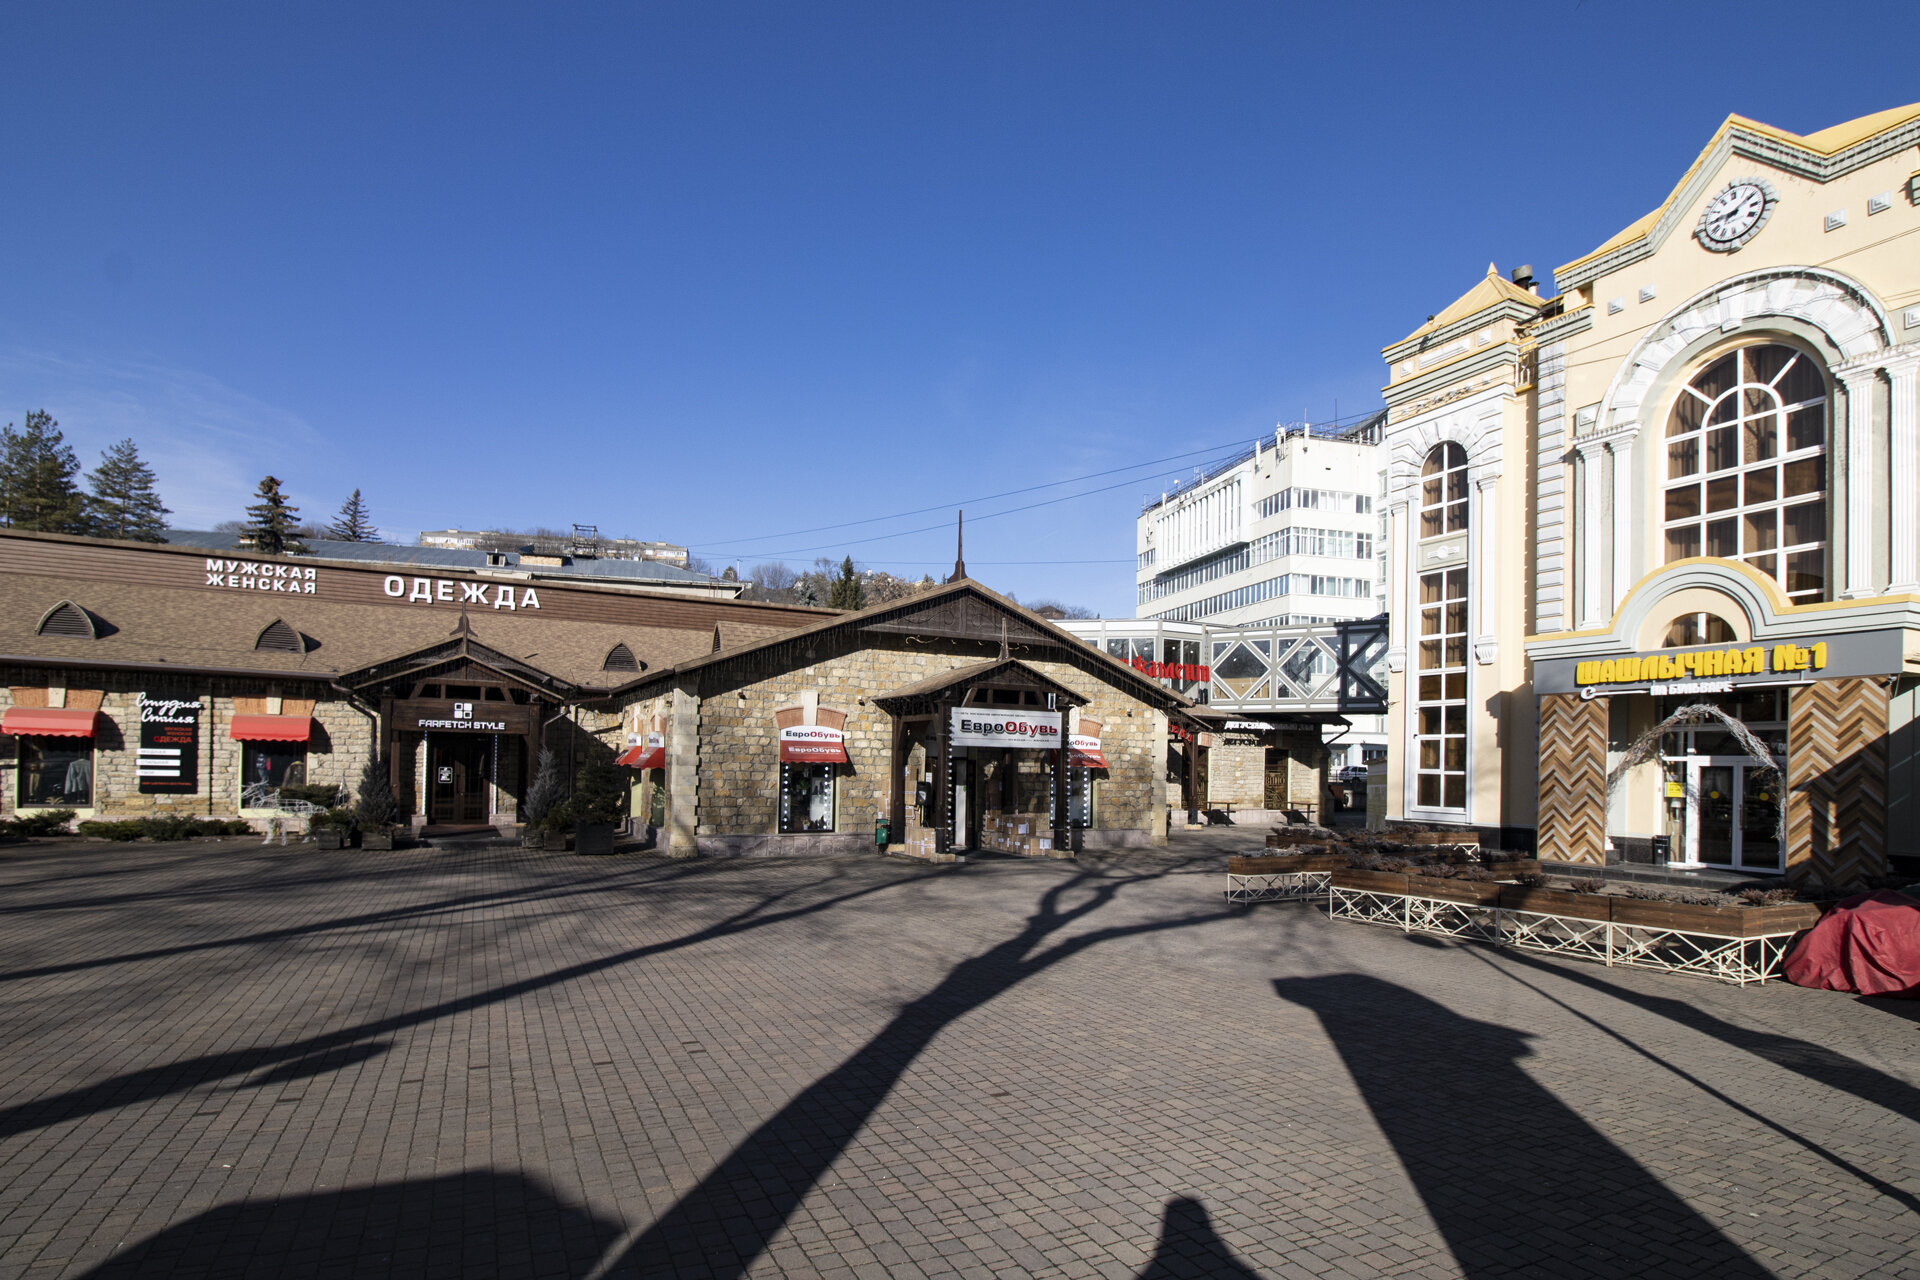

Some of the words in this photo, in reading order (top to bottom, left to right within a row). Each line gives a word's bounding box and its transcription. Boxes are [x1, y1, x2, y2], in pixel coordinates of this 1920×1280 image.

[206, 558, 317, 581] МУЖСКАЯ
[205, 573, 317, 594] ЖЕНСКАЯ
[384, 575, 541, 611] ОДЕЖДА
[1119, 655, 1210, 683] жамент
[1576, 646, 1765, 685] ШАШЛЫЧНАЯ
[136, 692, 201, 715] Студия
[141, 707, 195, 724] Стиля
[418, 719, 472, 729] FARFETCH
[473, 721, 505, 730] STYLE
[785, 730, 841, 739] ЕвроОбувь
[961, 719, 1059, 738] ЕвроОбувь
[788, 746, 842, 754] ЕвроОбувь
